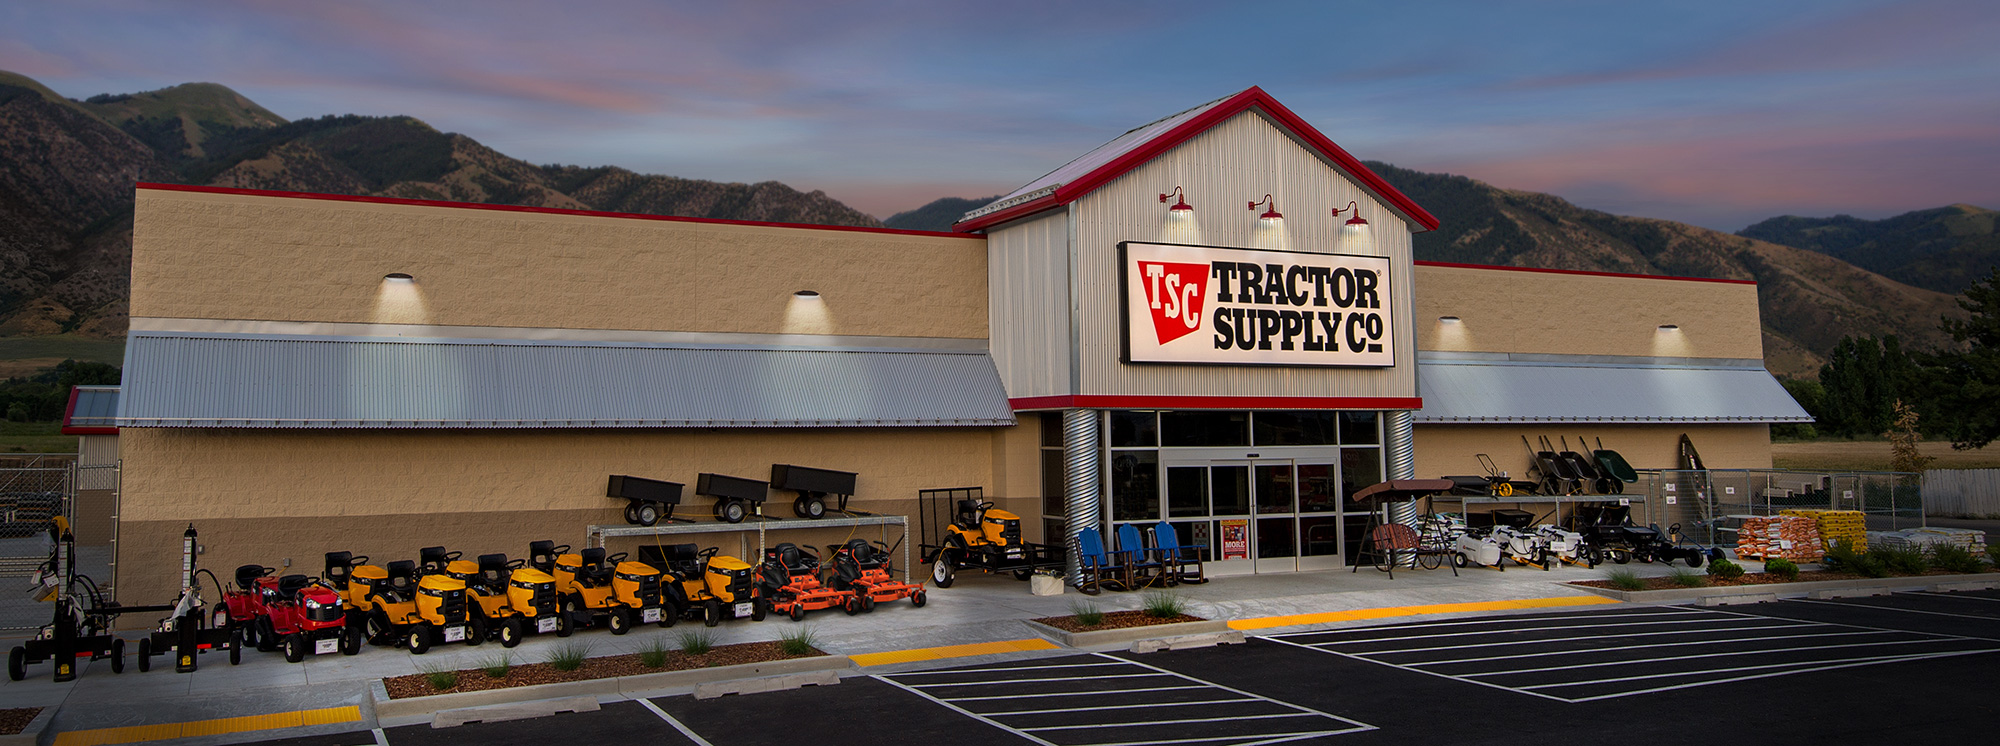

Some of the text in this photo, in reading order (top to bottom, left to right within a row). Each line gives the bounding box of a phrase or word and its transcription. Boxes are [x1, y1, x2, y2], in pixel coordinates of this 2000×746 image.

[1146, 264, 1198, 329] TSC
[1211, 261, 1381, 309] TRACTOR
[1213, 307, 1342, 352] SUPPLY
